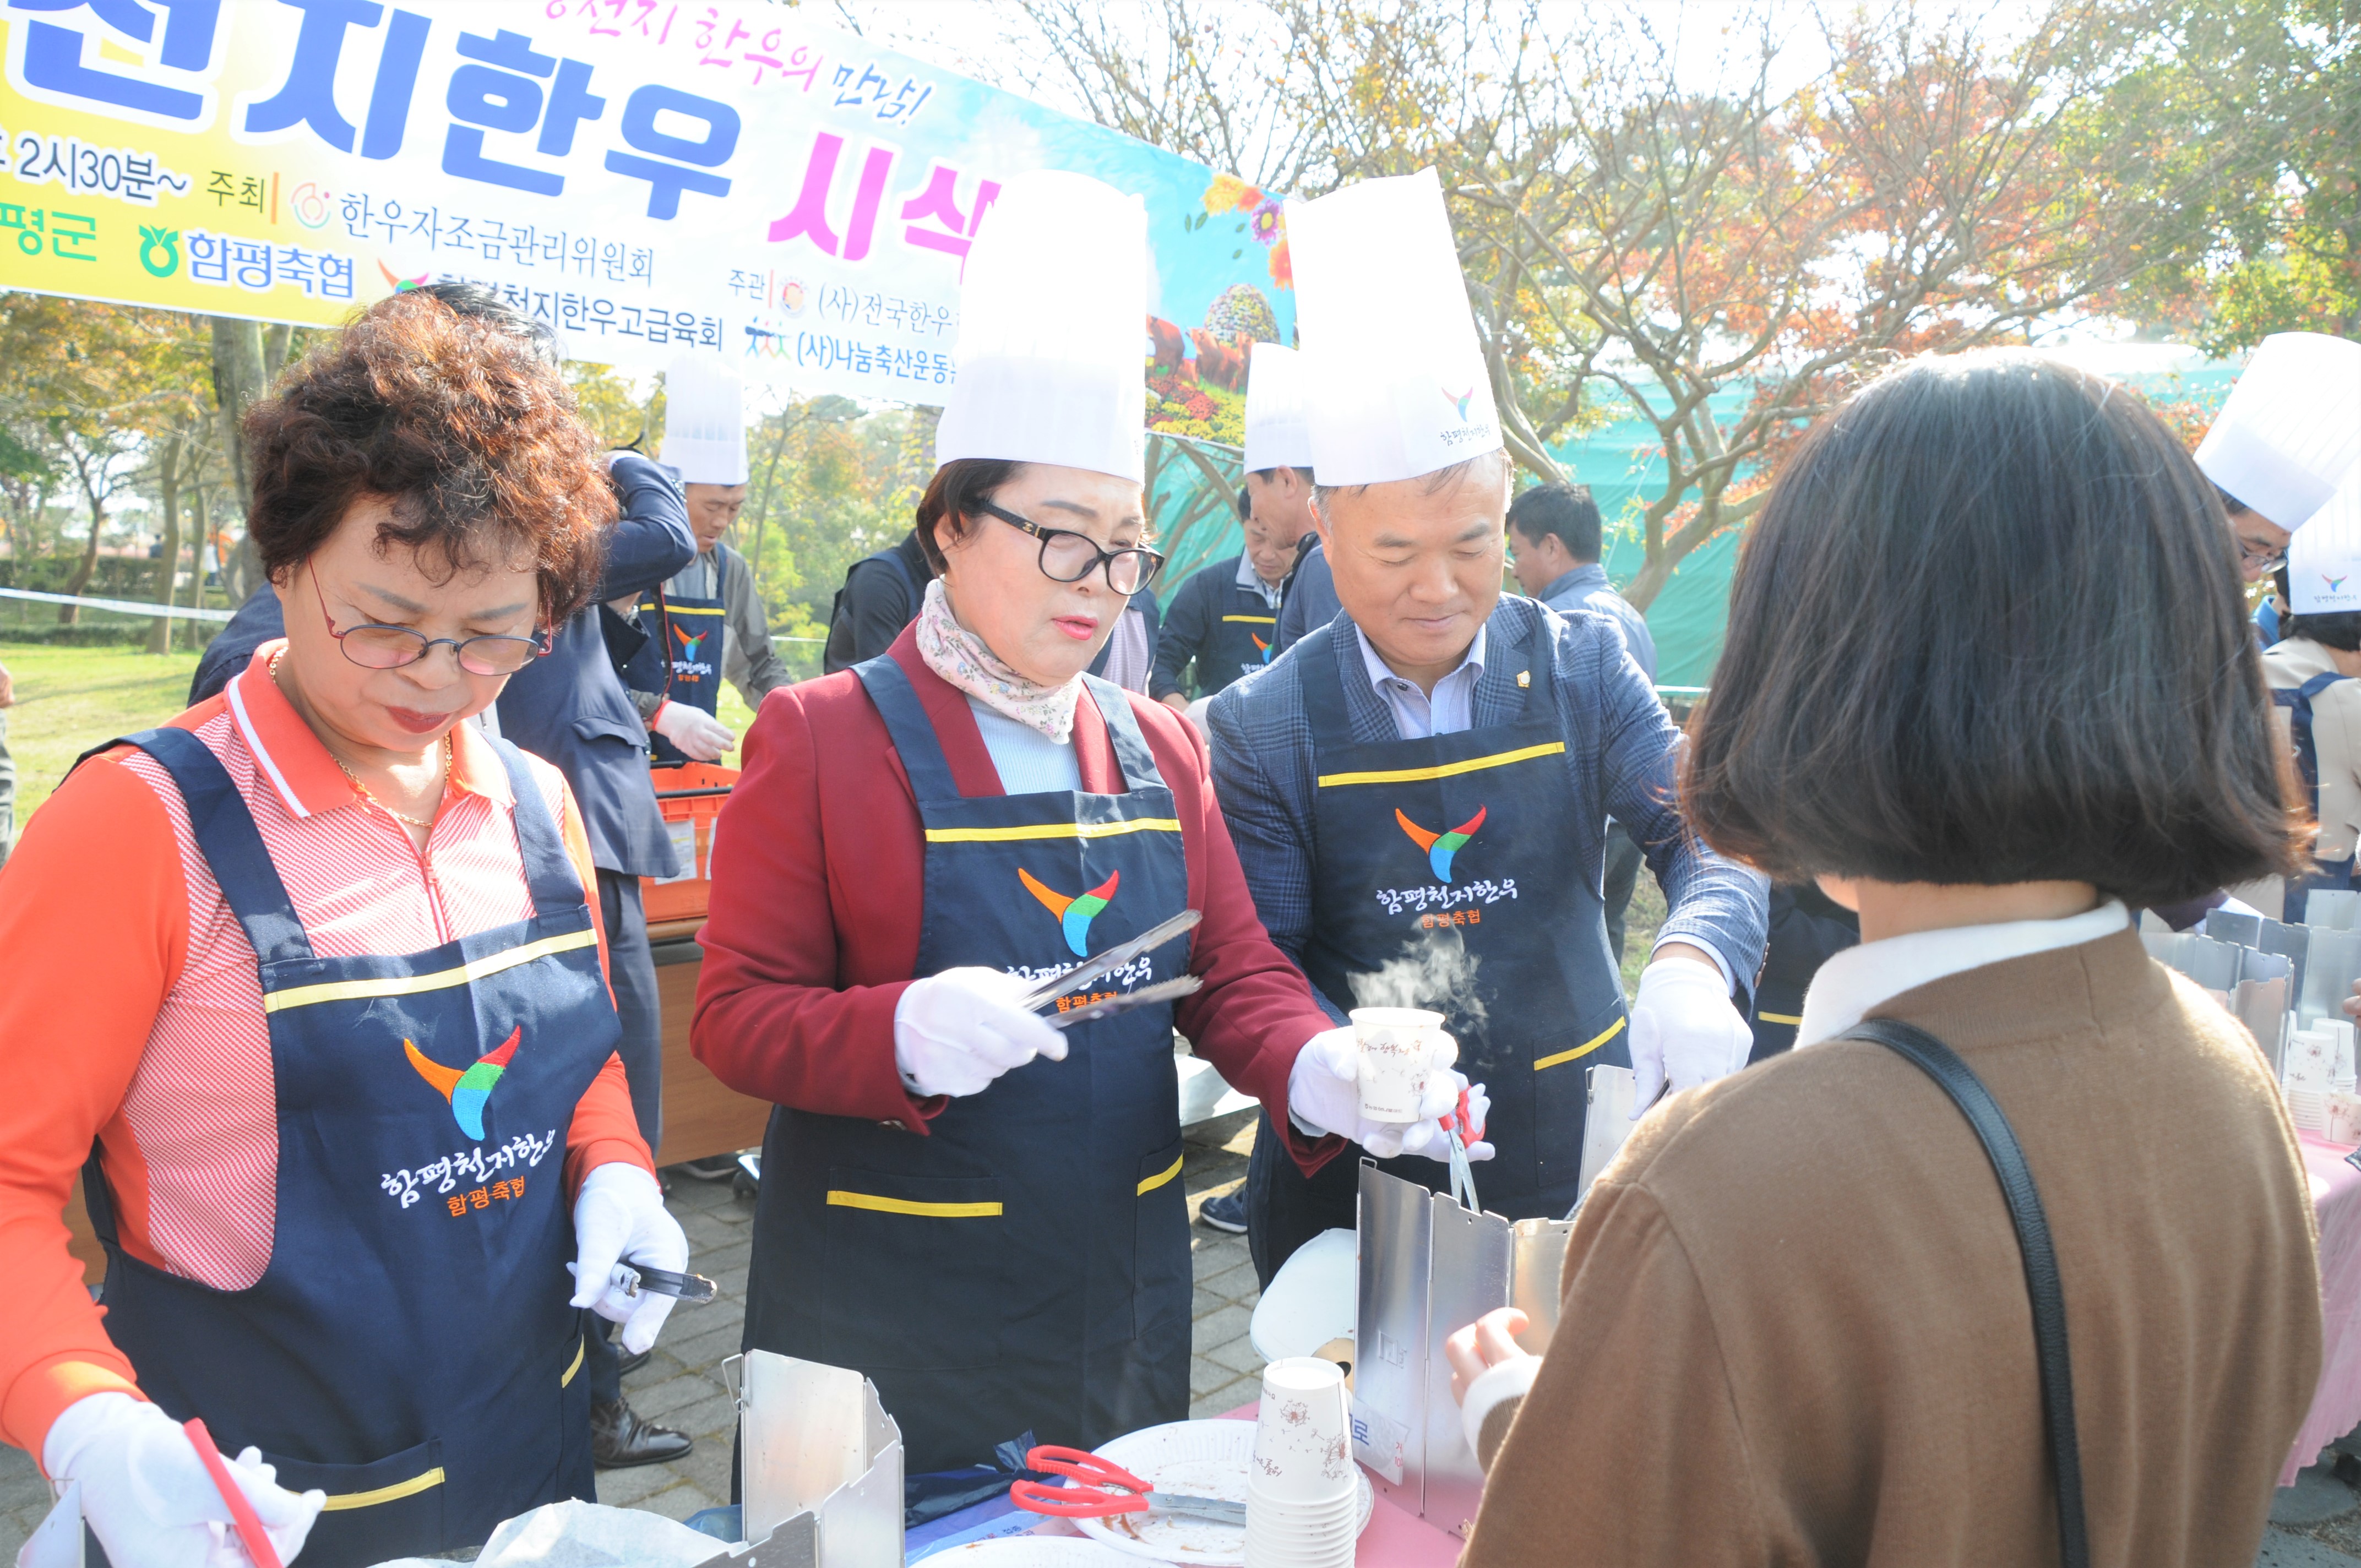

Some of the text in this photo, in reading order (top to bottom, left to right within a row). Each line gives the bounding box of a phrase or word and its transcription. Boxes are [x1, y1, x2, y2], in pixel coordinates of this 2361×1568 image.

[832, 63, 932, 125] 만남!
[206, 170, 265, 213] 주최
[339, 192, 655, 287] 한우자조금관리위원회
[189, 233, 353, 298] 함평축협
[728, 270, 766, 300] 주관
[437, 274, 723, 351] 천지한우고급육회
[819, 282, 960, 336] (사)전국한우
[1377, 879, 1517, 915] 함평천지한우
[1421, 909, 1481, 929] 함평축협
[447, 1176, 525, 1217] 함평축협
